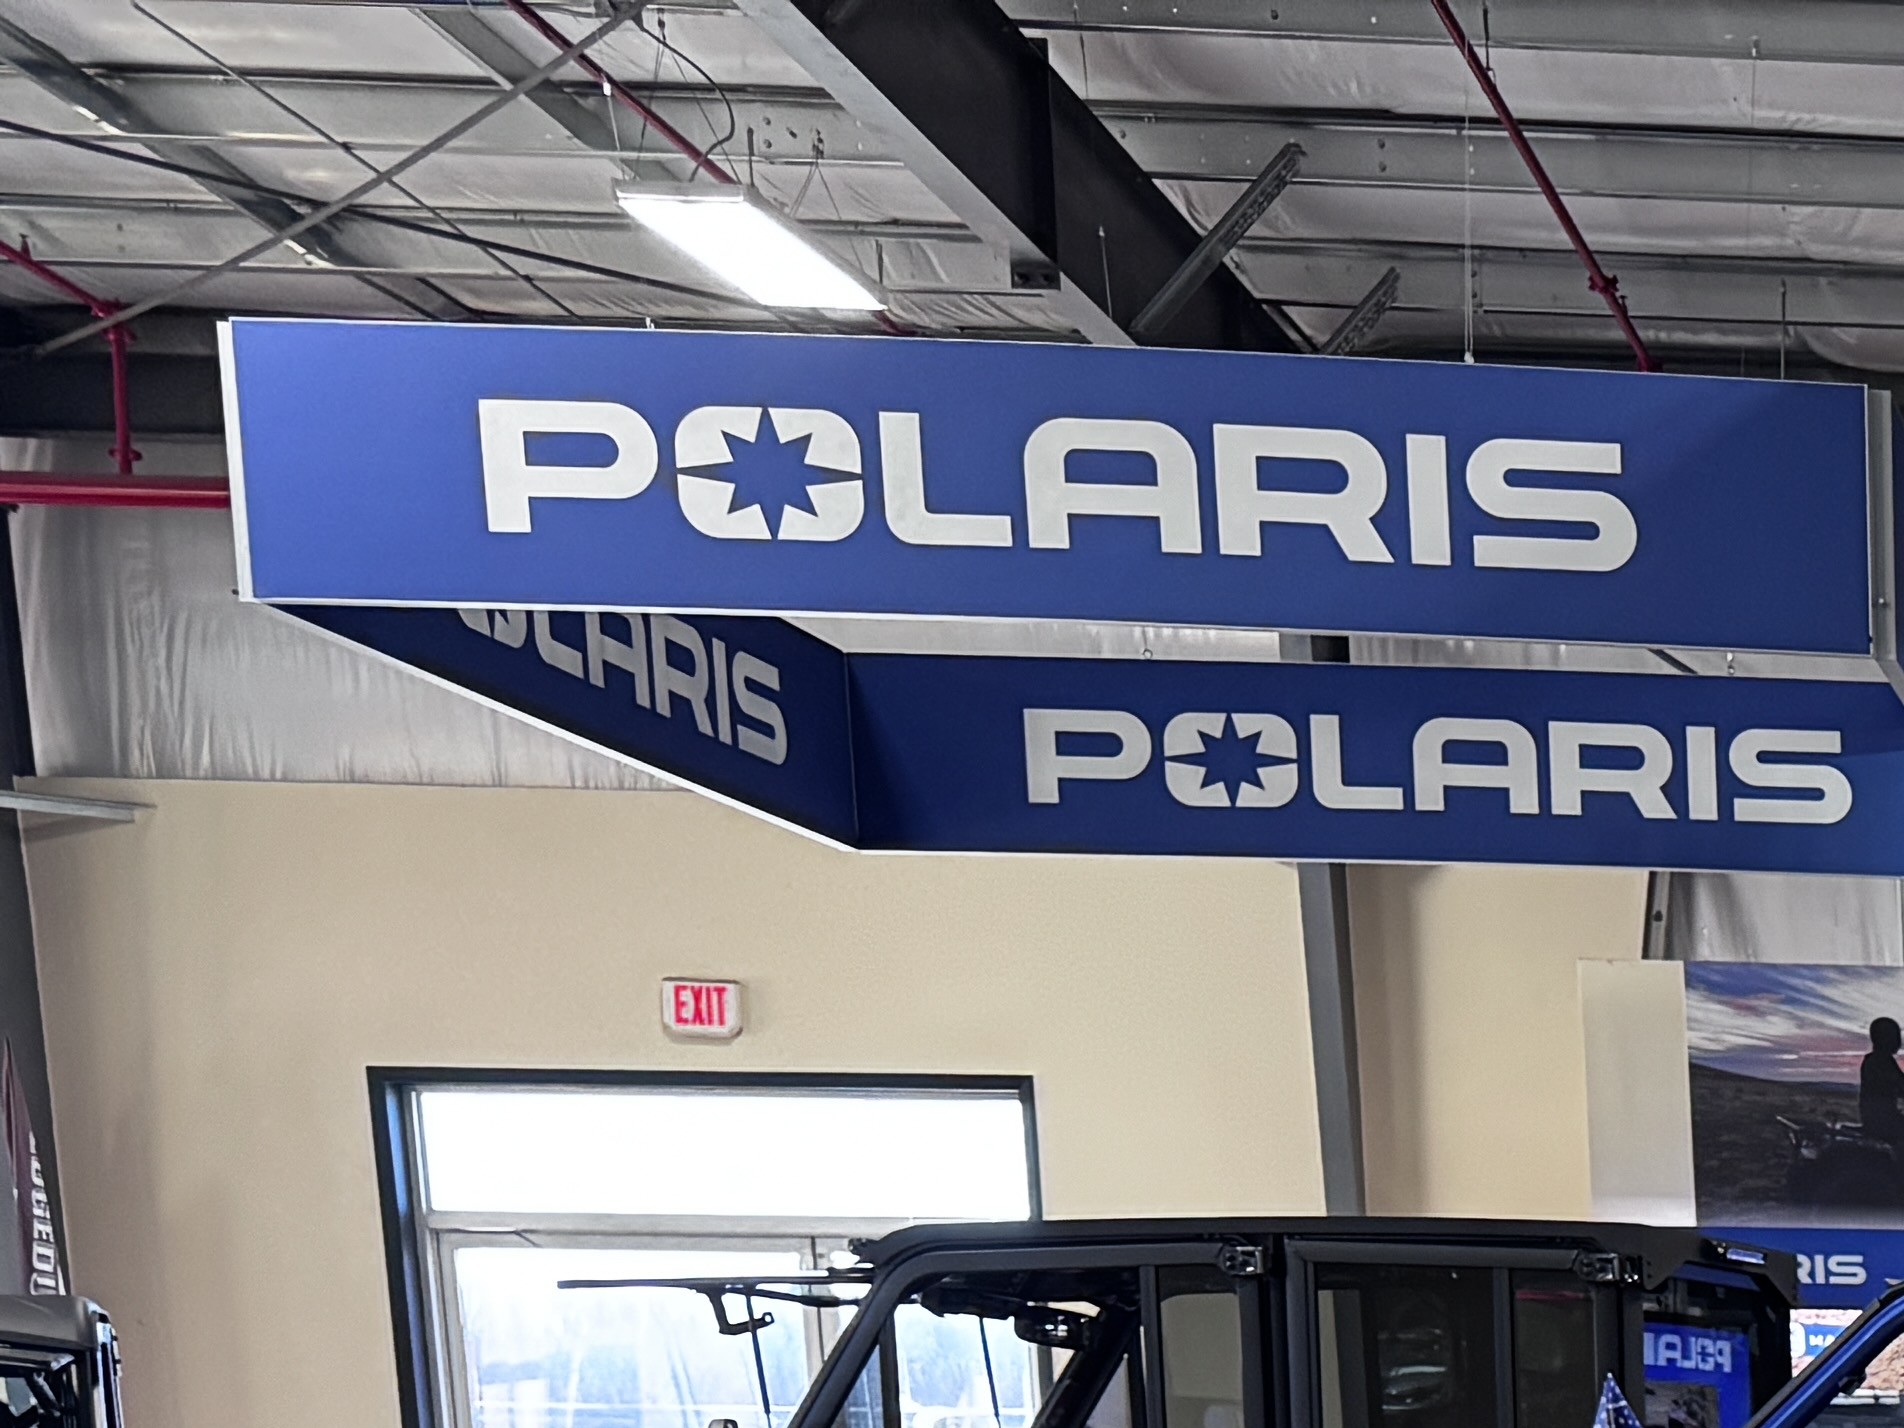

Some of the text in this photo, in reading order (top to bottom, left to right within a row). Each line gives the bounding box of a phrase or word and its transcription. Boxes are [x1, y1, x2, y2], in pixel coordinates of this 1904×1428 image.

[478, 399, 1637, 572] POLARIS
[1024, 708, 1852, 824] POLARIS
[674, 984, 727, 1028] EXIT
